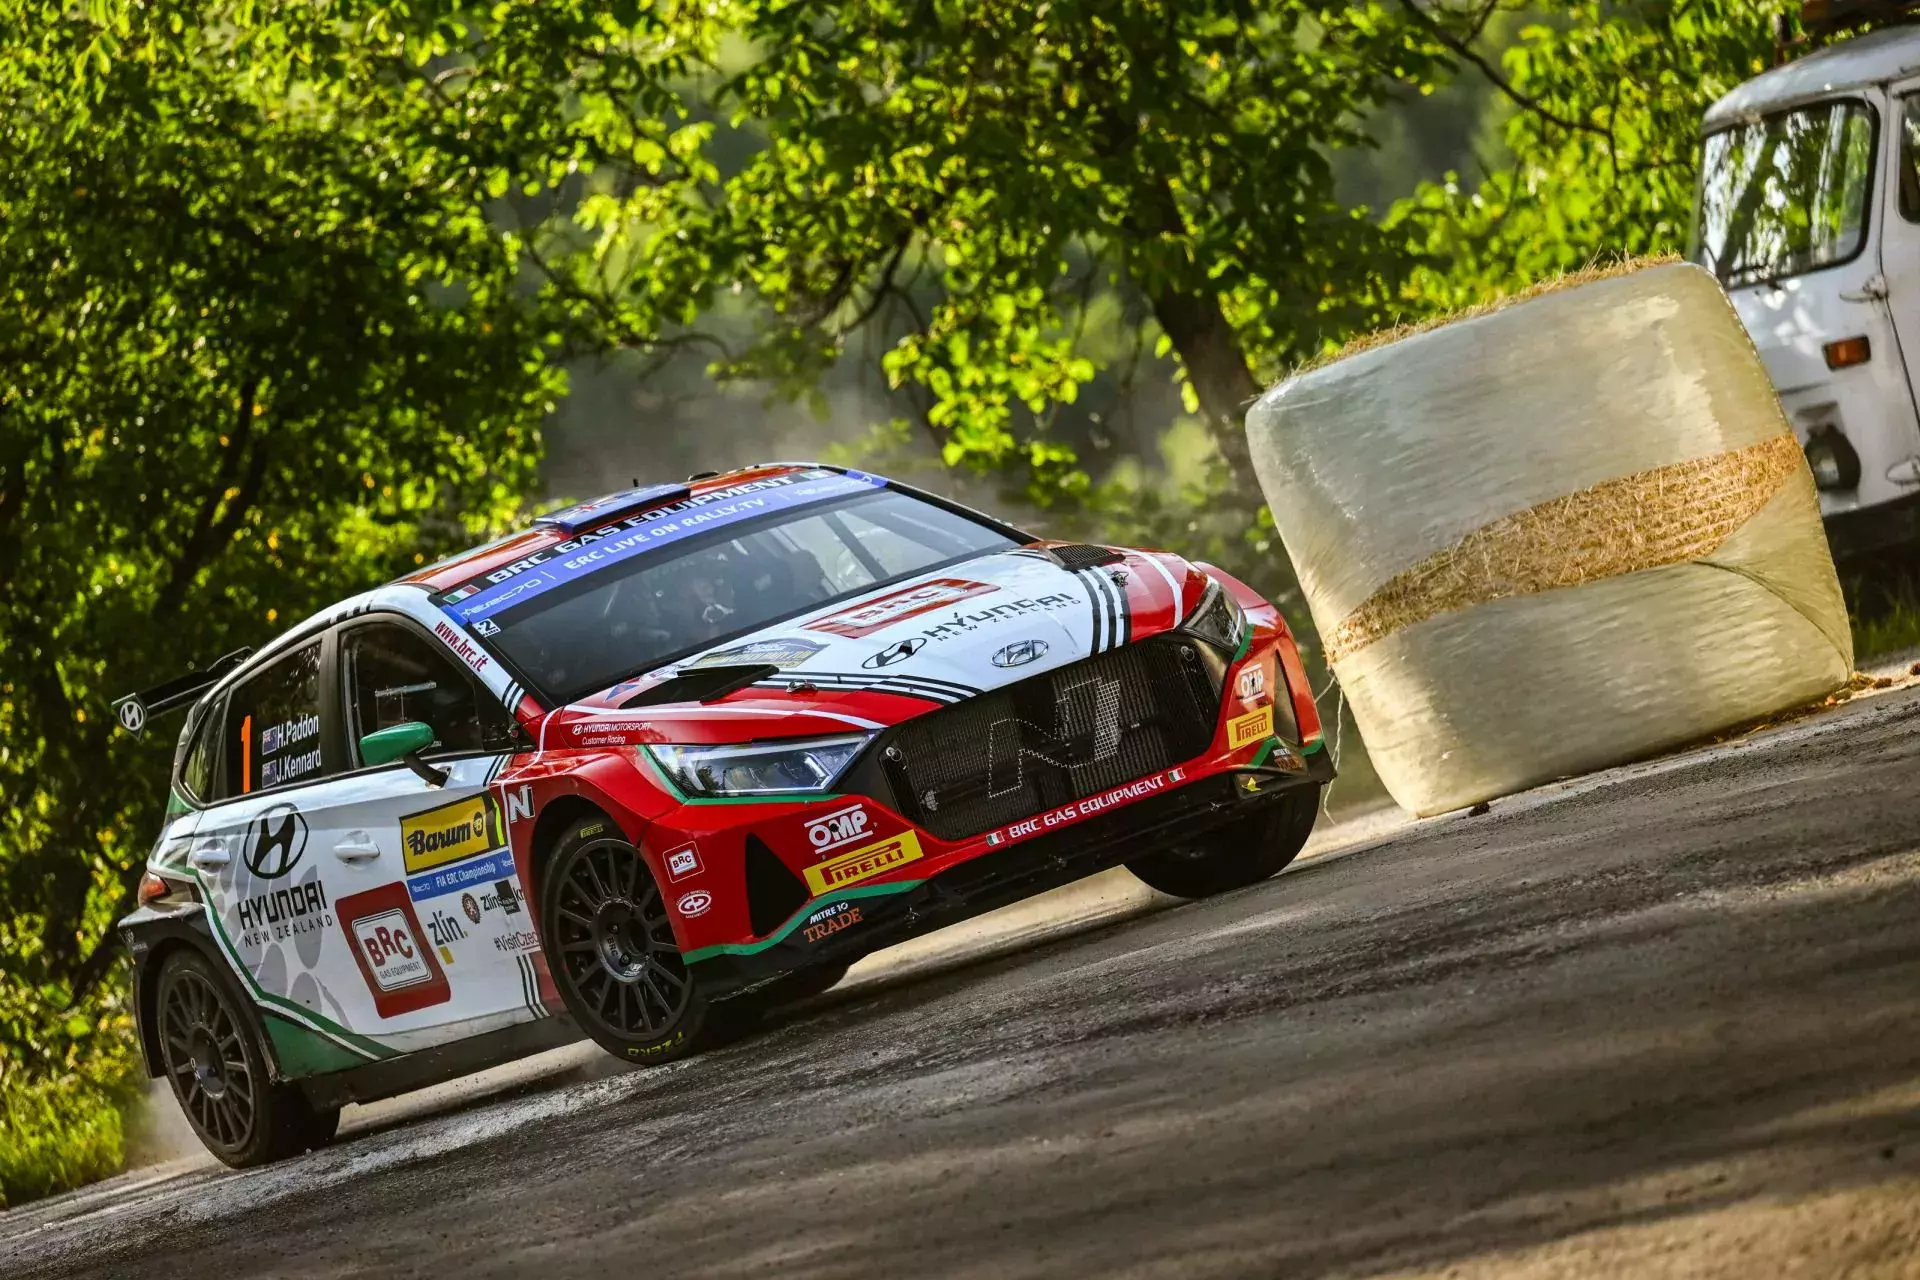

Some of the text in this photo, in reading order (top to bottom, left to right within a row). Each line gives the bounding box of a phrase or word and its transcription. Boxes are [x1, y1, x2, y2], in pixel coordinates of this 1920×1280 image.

[485, 552, 551, 584] BRC
[555, 524, 621, 553] GAS
[627, 476, 794, 527] EQUIPMENT
[564, 551, 605, 570] ERC
[604, 533, 650, 553] LIVE
[651, 523, 678, 538] ON
[681, 498, 766, 527] RALLY.TV
[922, 593, 1075, 637] HYUNDAI
[937, 600, 1081, 642] NEW ZEALAND
[434, 620, 489, 672] www.brc.it
[277, 714, 319, 748] H.Paddon
[582, 734, 626, 745] Customer Racing
[1236, 712, 1267, 741] PIRELLI
[240, 714, 251, 794] 1
[276, 743, 322, 783] J.Kennard
[1009, 775, 1164, 838] BRC GAS EQUIPMENT
[407, 822, 471, 856] Barum
[809, 810, 868, 846] OMP
[435, 876, 447, 888] FIA
[446, 873, 459, 885] ERC
[458, 861, 497, 880] Championship
[672, 854, 692, 869] BRC
[820, 841, 905, 886] PIRELLI
[237, 880, 327, 930] HYUNDAI
[810, 902, 848, 924] MITRE 10
[244, 914, 332, 948] NEW ZEALAND
[804, 908, 863, 943] TRADE
[363, 926, 414, 967] BRC
[391, 961, 421, 977] EQUIPMENT
